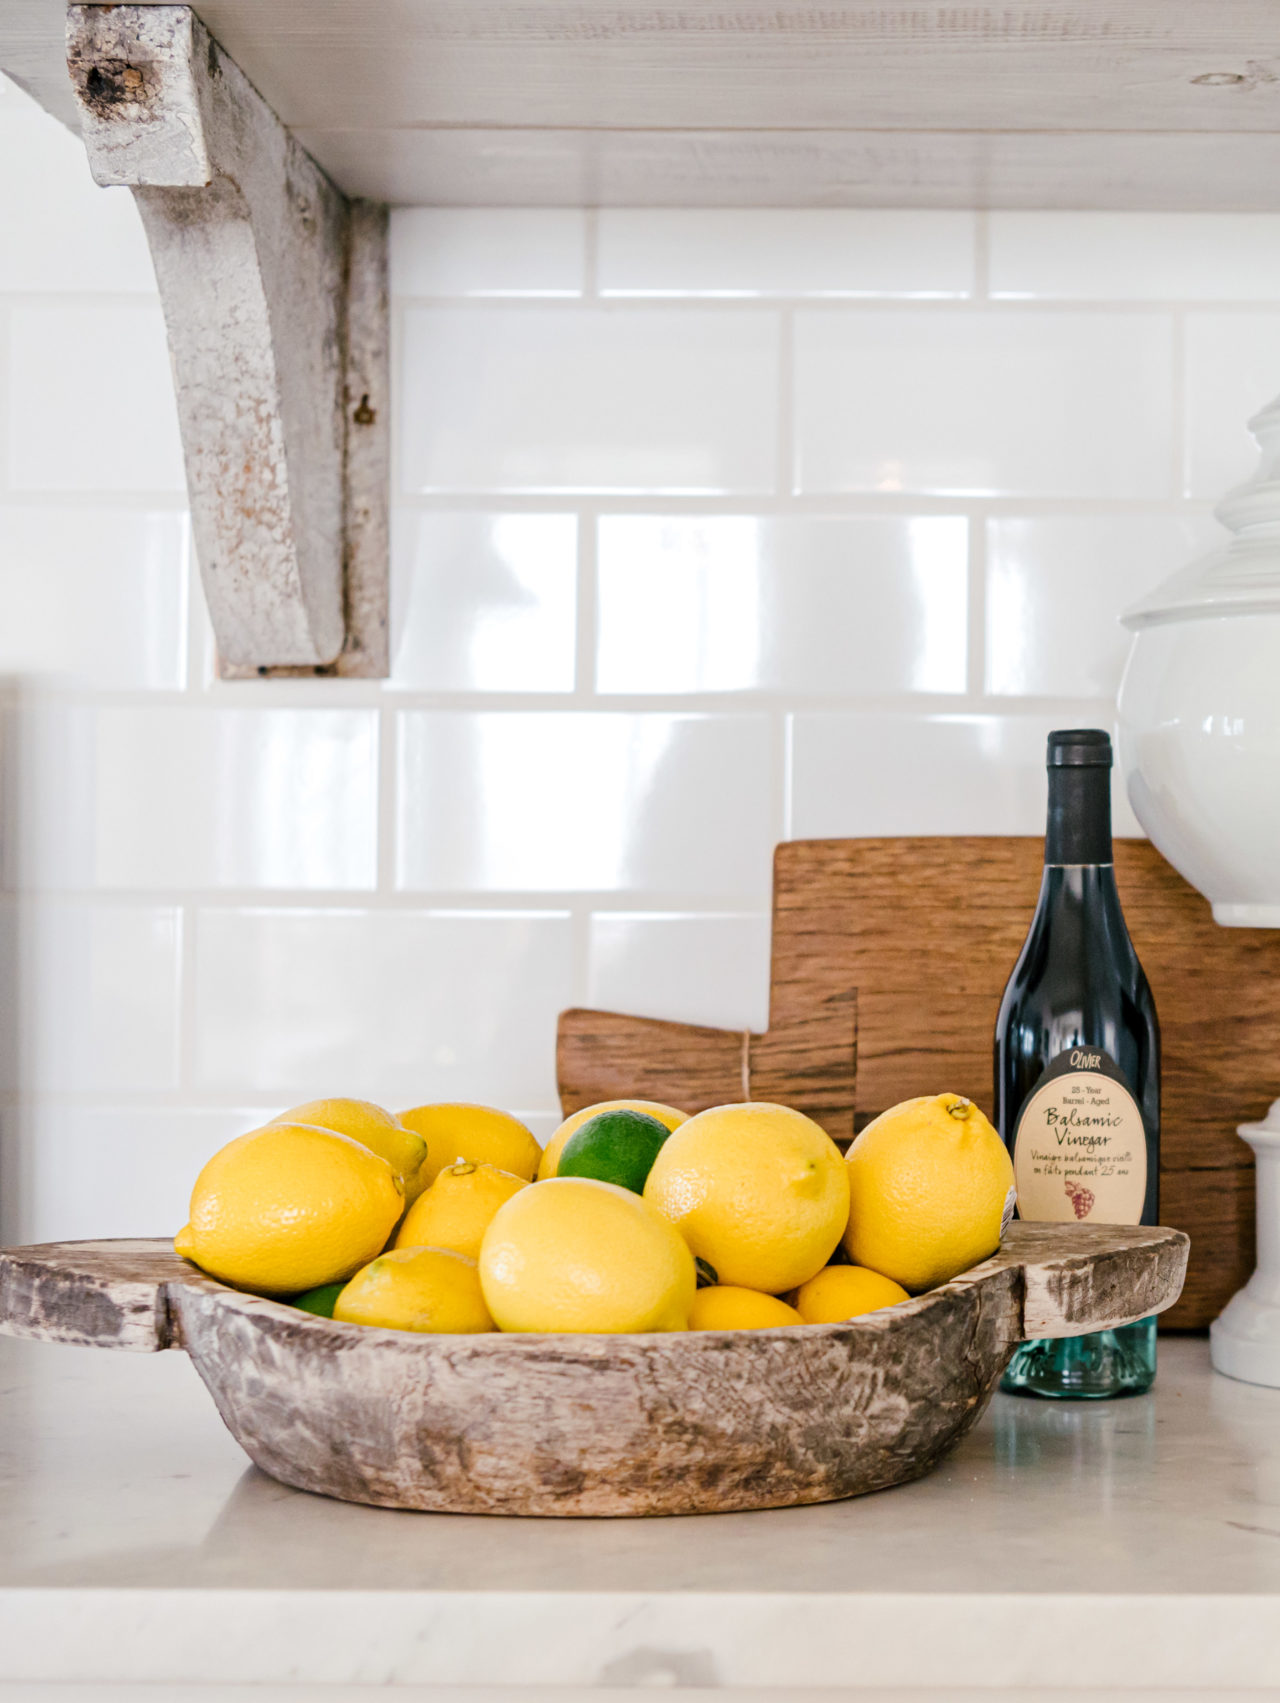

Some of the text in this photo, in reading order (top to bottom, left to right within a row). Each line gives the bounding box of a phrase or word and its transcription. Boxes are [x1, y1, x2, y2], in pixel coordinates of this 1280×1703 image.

[1086, 1086, 1102, 1094] Year
[1062, 1097, 1085, 1105] Barrel
[1090, 1097, 1110, 1106] Aged
[1043, 1107, 1124, 1127] Balsamic
[1054, 1127, 1112, 1154] Vinegar
[1064, 1166, 1099, 1180] pendant
[1101, 1166, 1116, 1176] 25
